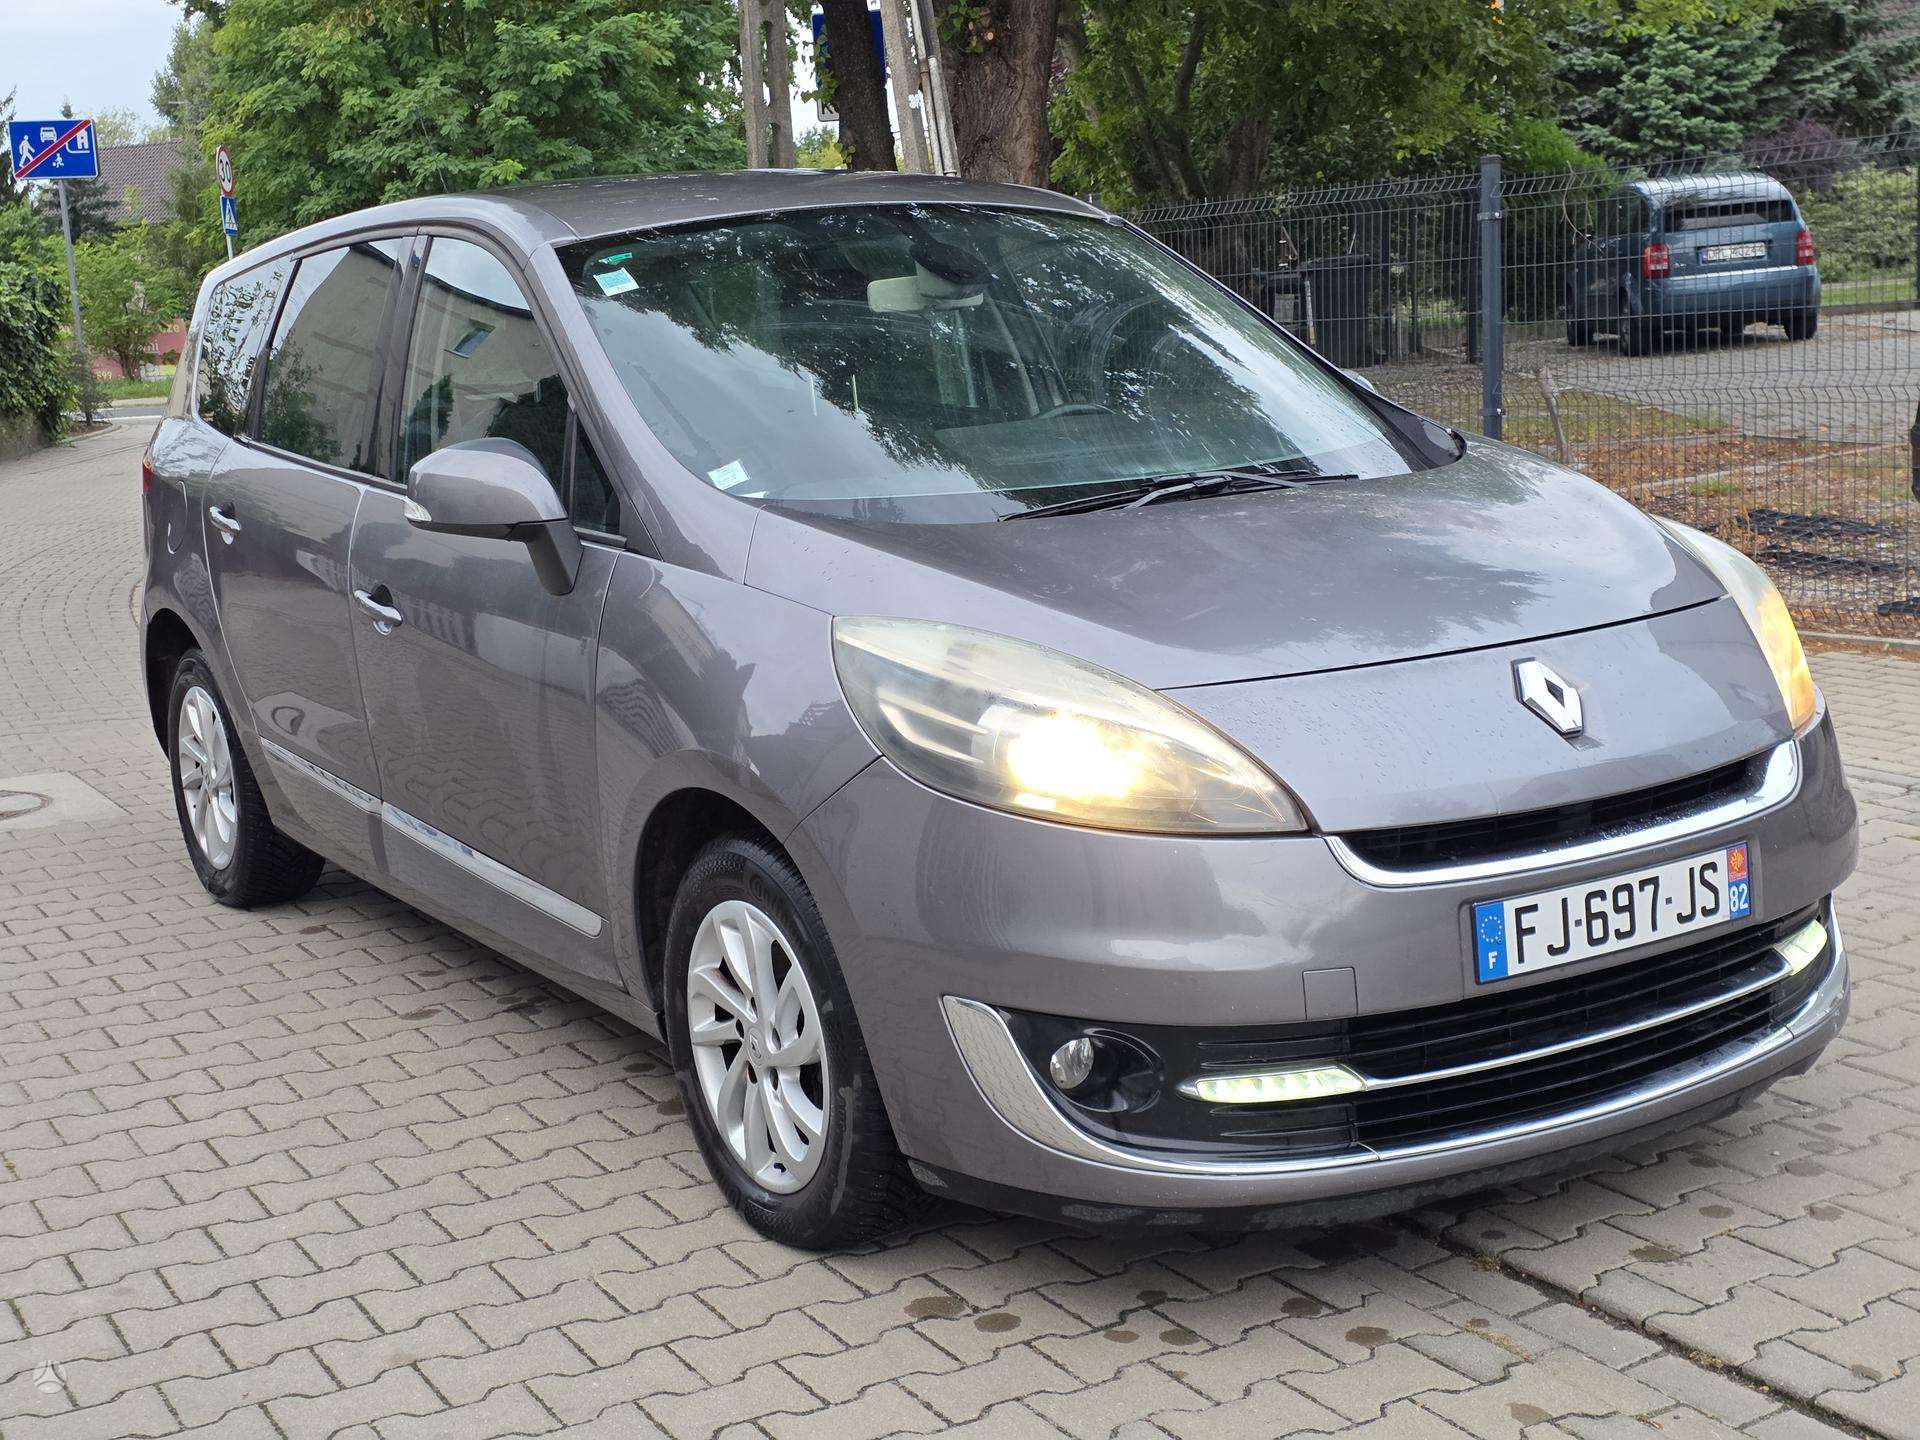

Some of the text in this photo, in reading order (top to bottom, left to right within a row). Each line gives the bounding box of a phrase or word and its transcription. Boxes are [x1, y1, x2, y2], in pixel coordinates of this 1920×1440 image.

[219, 159, 232, 183] 30
[1730, 883, 1749, 912] 82
[1515, 861, 1721, 964] FJ-697-JS
[1488, 951, 1498, 969] F
